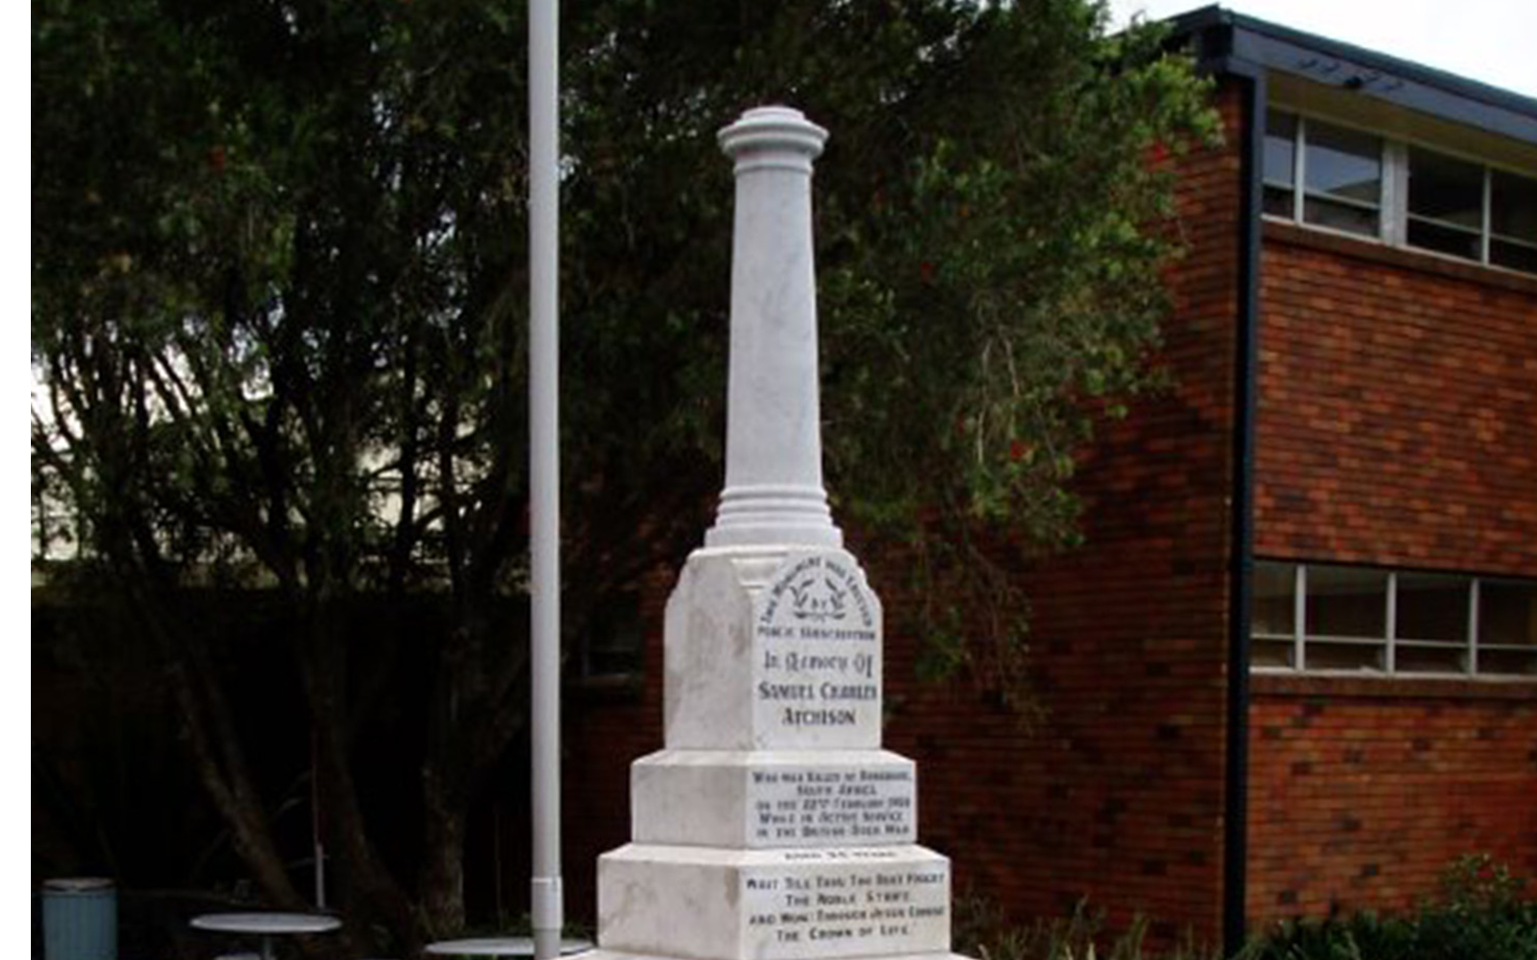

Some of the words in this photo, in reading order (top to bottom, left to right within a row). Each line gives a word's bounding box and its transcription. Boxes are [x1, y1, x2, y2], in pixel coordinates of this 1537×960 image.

[759, 682, 813, 699] SAMUEL
[783, 708, 855, 725] ATCHISON
[786, 895, 808, 906] THE
[778, 930, 798, 941] THE
